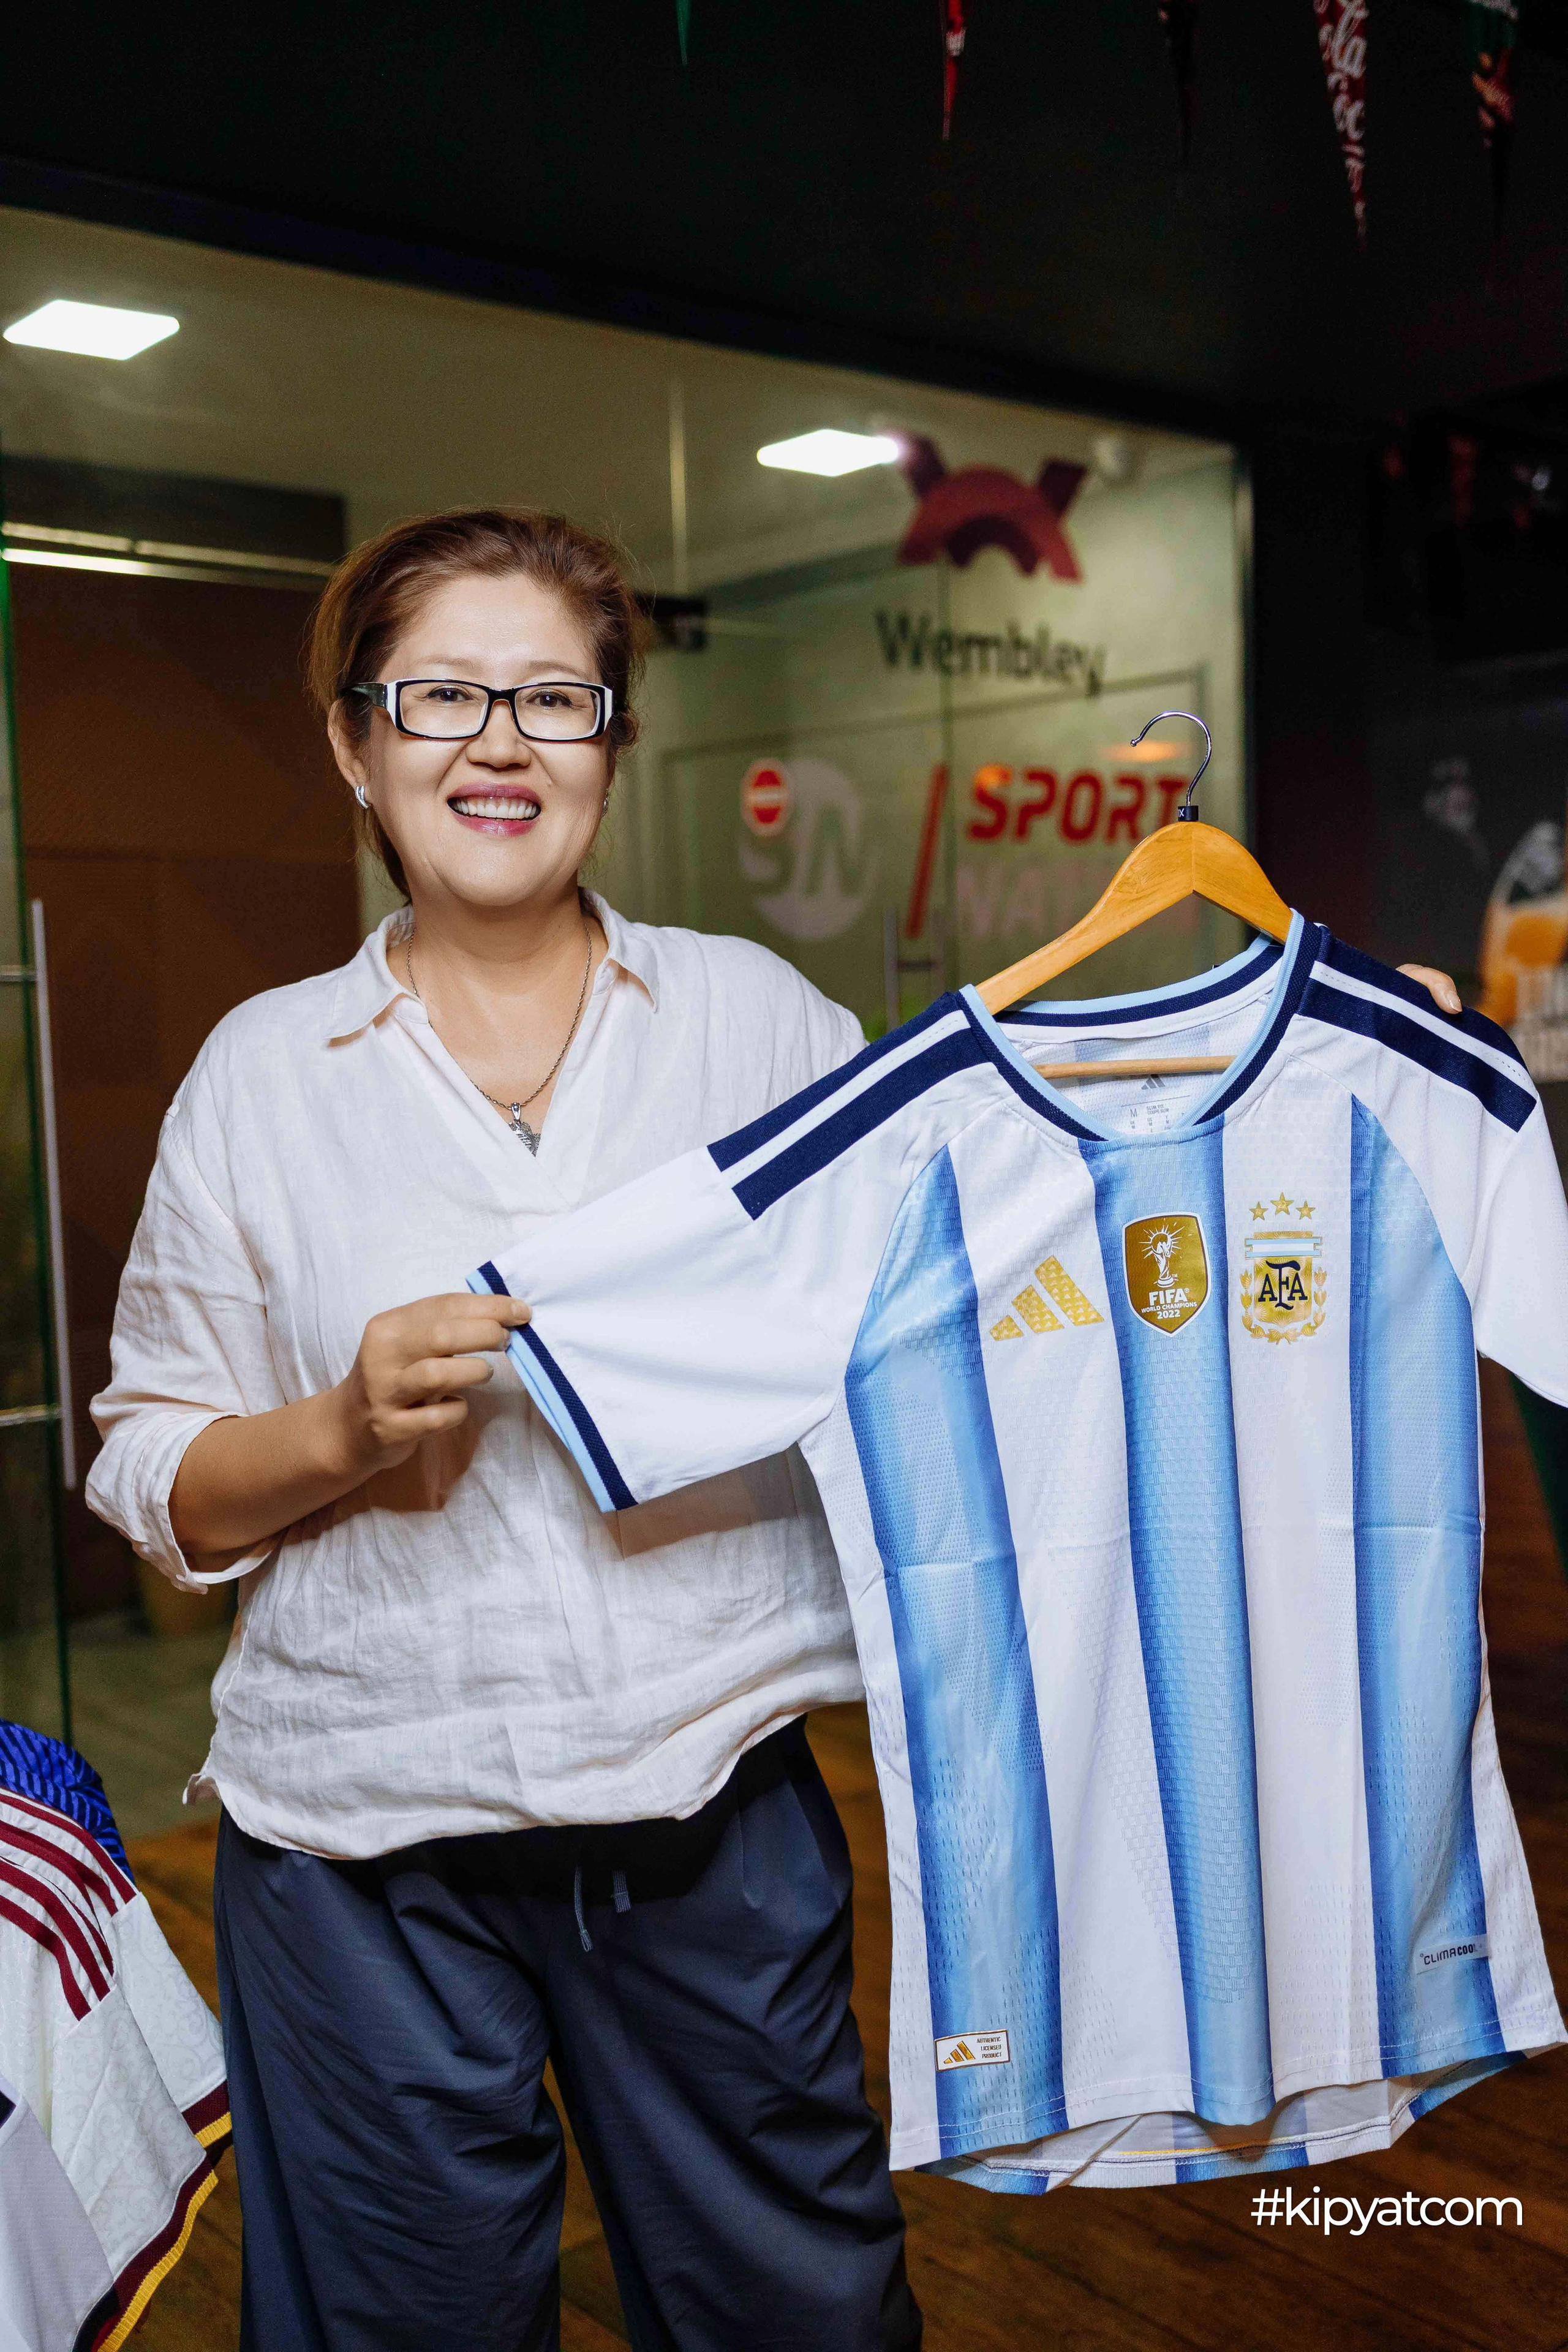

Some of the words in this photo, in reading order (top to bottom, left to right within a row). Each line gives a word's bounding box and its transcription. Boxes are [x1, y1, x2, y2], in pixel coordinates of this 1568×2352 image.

[875, 610, 1107, 698] Wembley
[968, 764, 1191, 843] SPORT
[1130, 1108, 1137, 1117] M
[1258, 1260, 1308, 1310] AFA
[1157, 1310, 1180, 1319] 2022
[1162, 1302, 1197, 1310] CHAMPIONS
